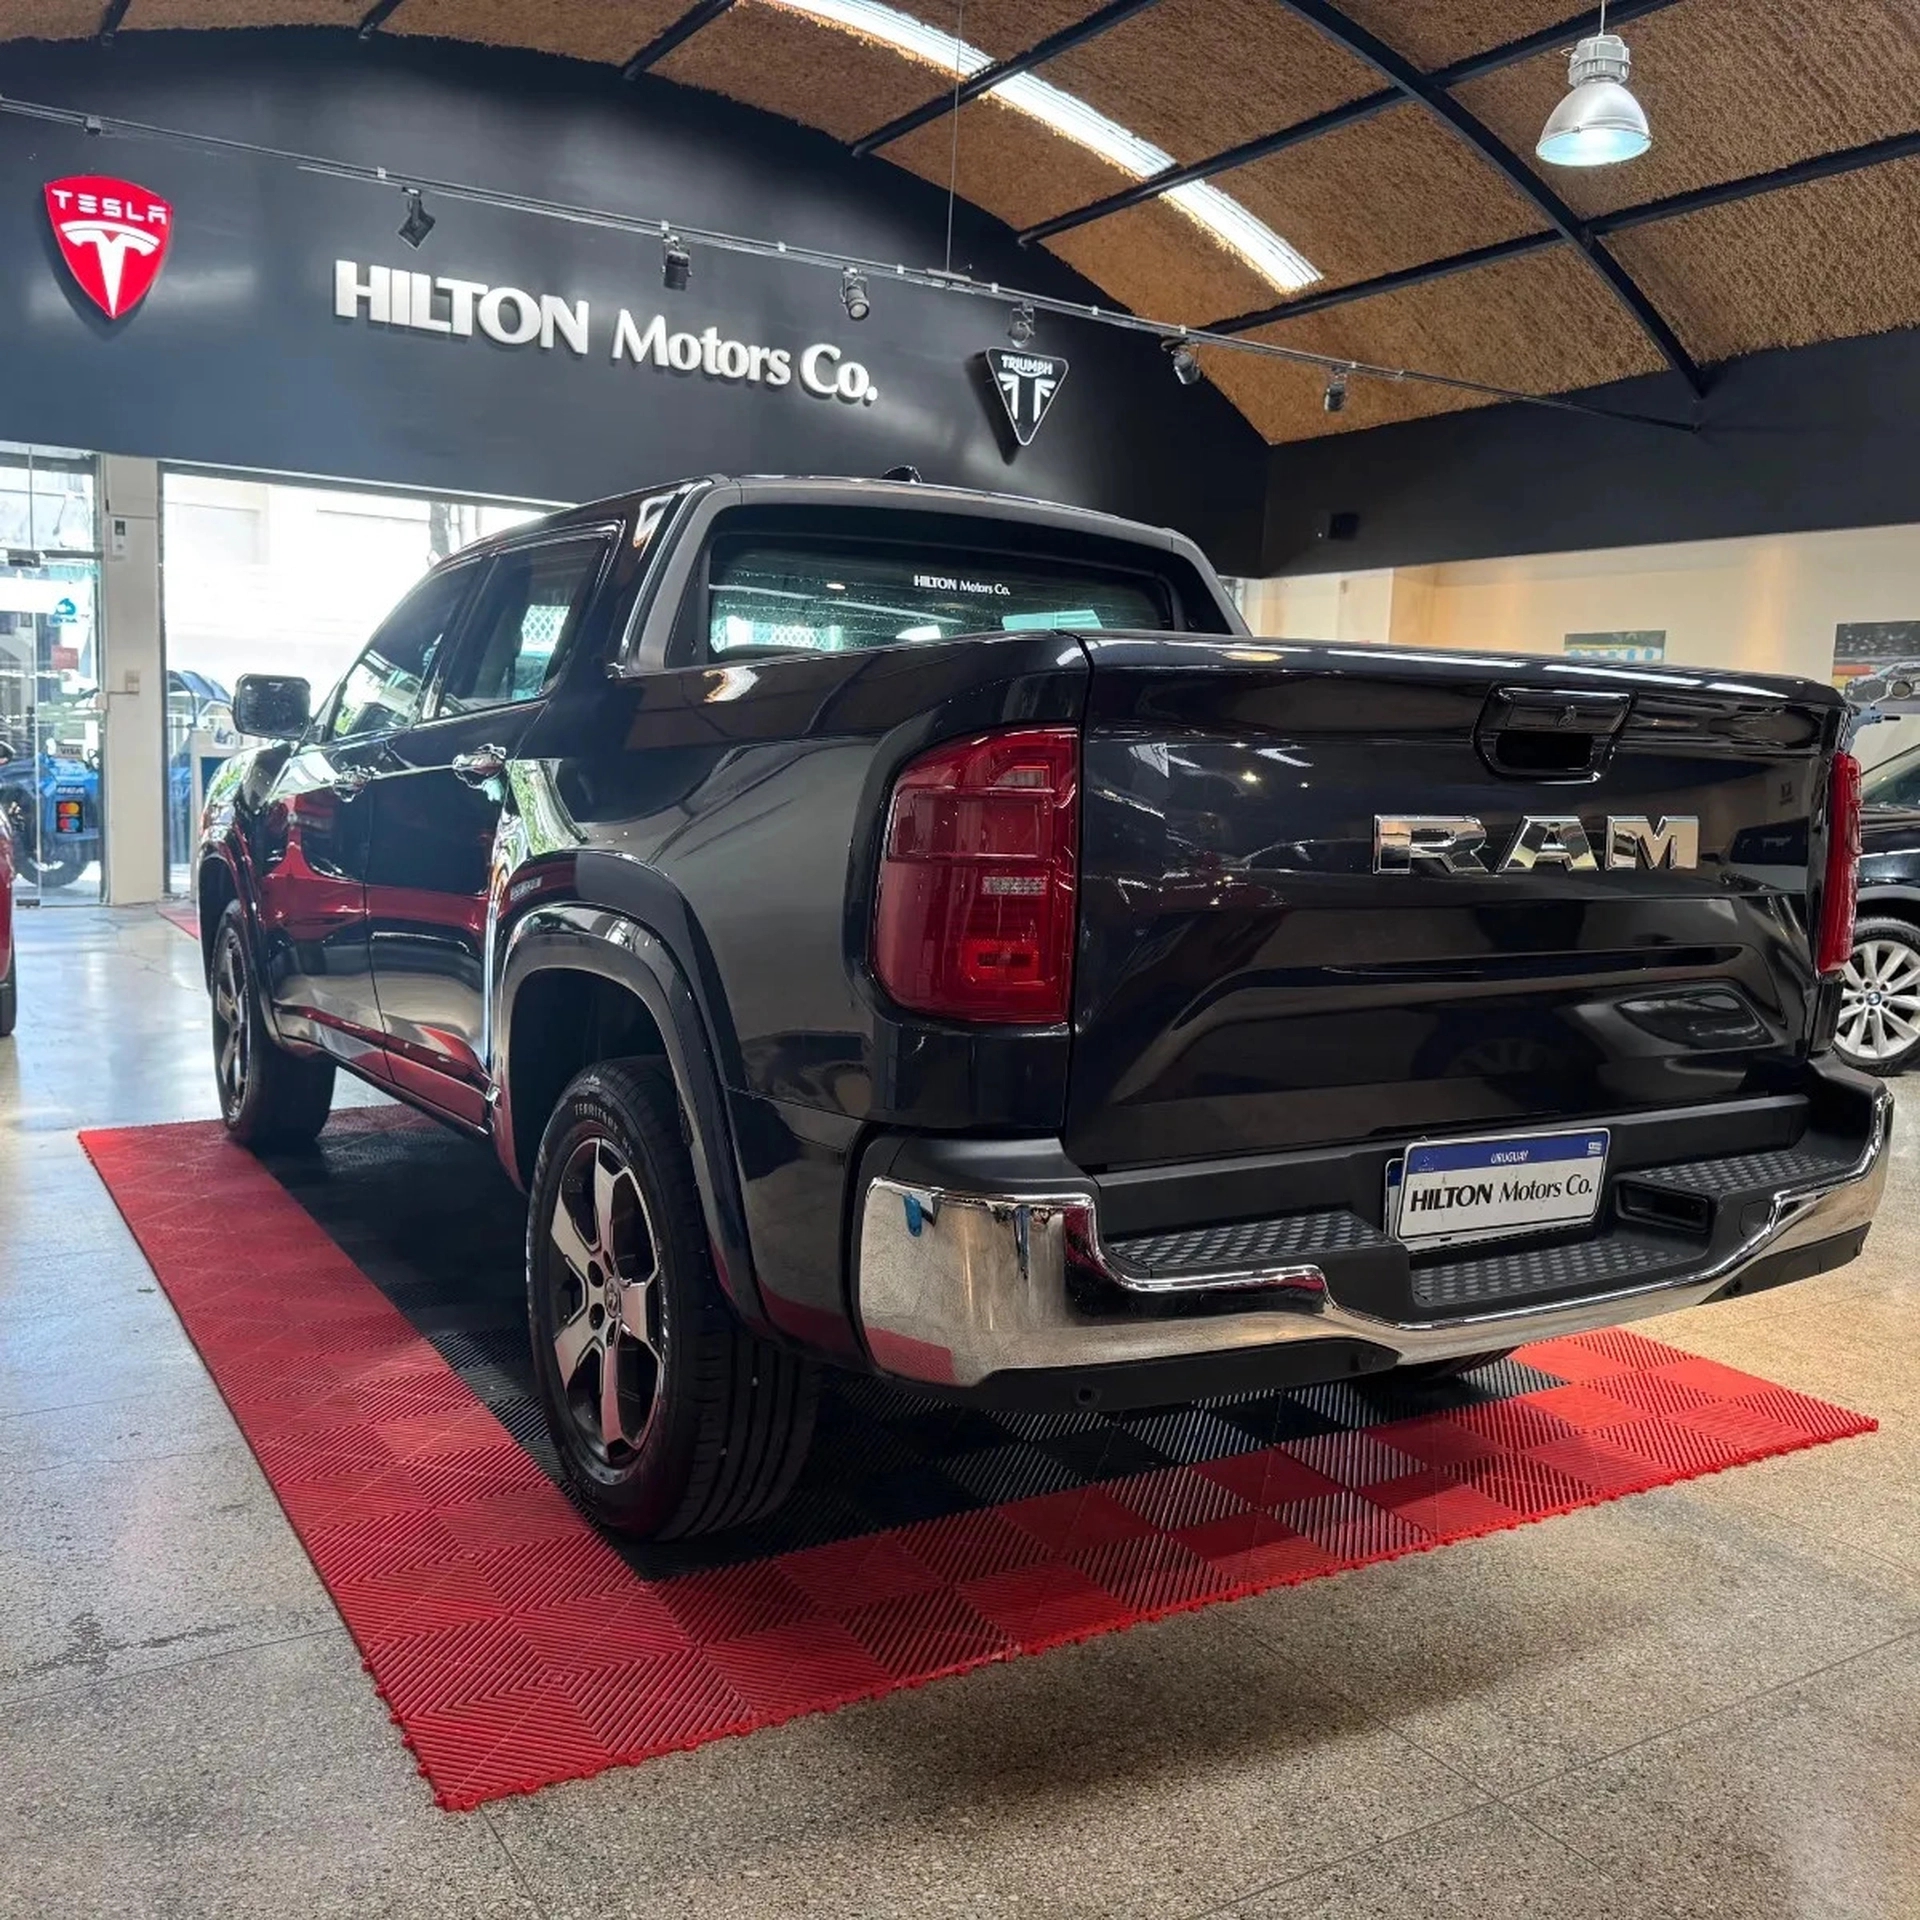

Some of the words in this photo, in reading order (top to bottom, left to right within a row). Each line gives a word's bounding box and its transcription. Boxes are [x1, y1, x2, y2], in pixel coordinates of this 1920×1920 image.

[51, 189, 167, 223] TESLA
[335, 259, 589, 355] HILTON
[611, 308, 792, 387] Motors
[799, 342, 878, 402] Co.
[1001, 355, 1053, 375] TRIUMPH
[913, 574, 957, 591] HILTON
[960, 580, 993, 594] Motors
[994, 583, 1011, 596] Co.
[60, 747, 81, 755] VISA
[1372, 813, 1699, 875] RAM
[1490, 1150, 1530, 1164] URUGUAY
[1410, 1184, 1494, 1212] HILTON
[1498, 1179, 1562, 1203] Motors
[1566, 1174, 1593, 1195] Co.
